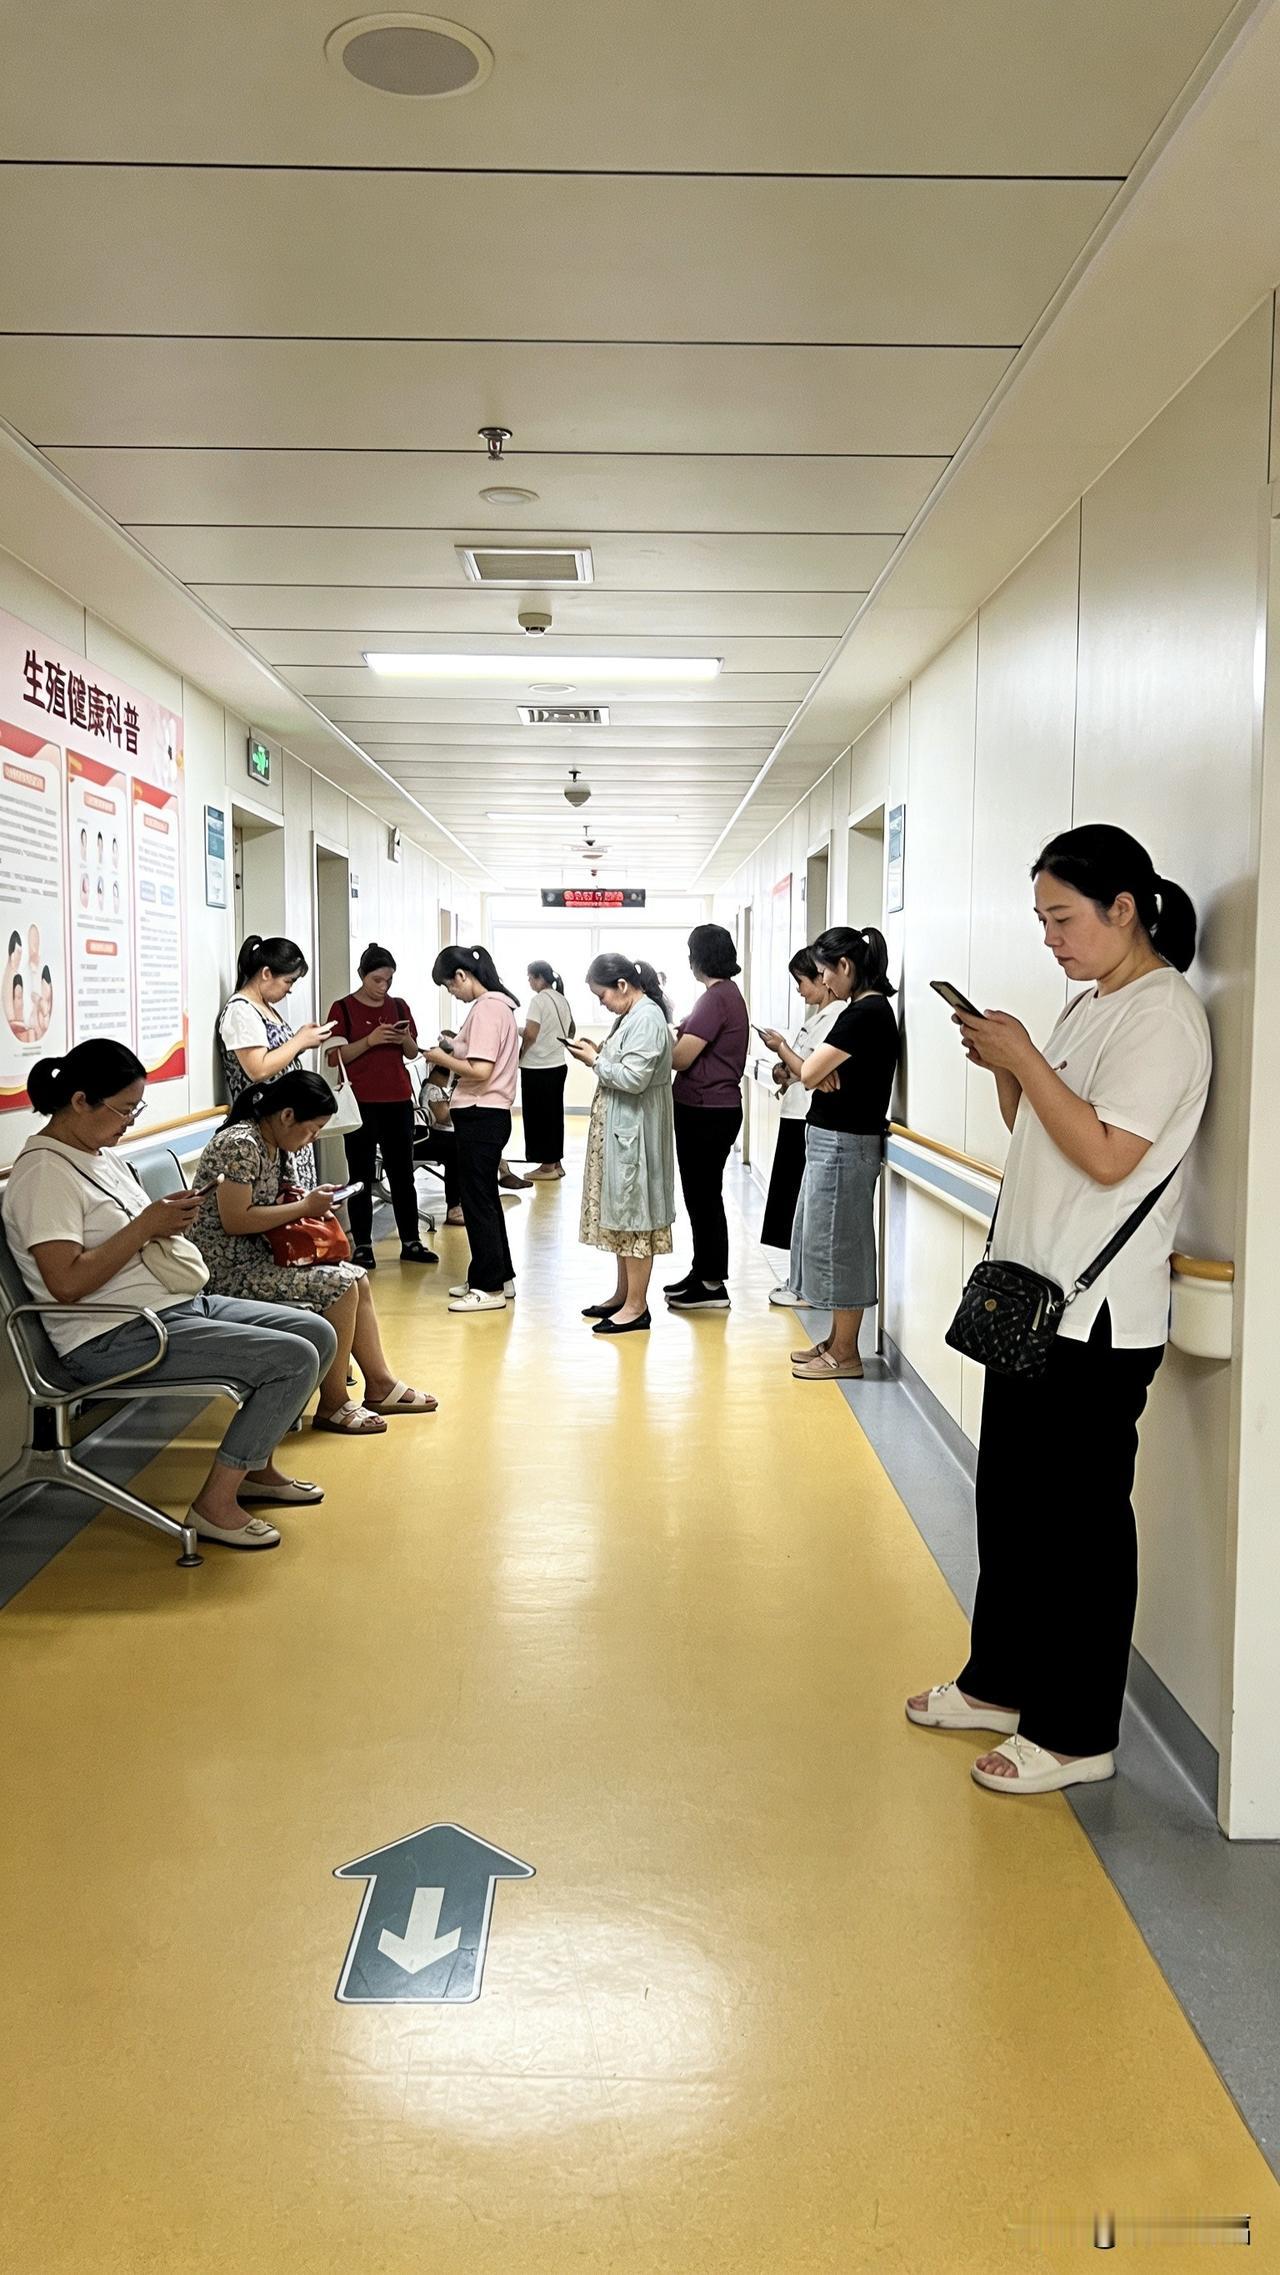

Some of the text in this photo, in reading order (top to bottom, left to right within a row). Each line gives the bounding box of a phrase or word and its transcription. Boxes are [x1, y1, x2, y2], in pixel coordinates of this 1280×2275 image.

[23, 650, 139, 754] 生殖健康科普
